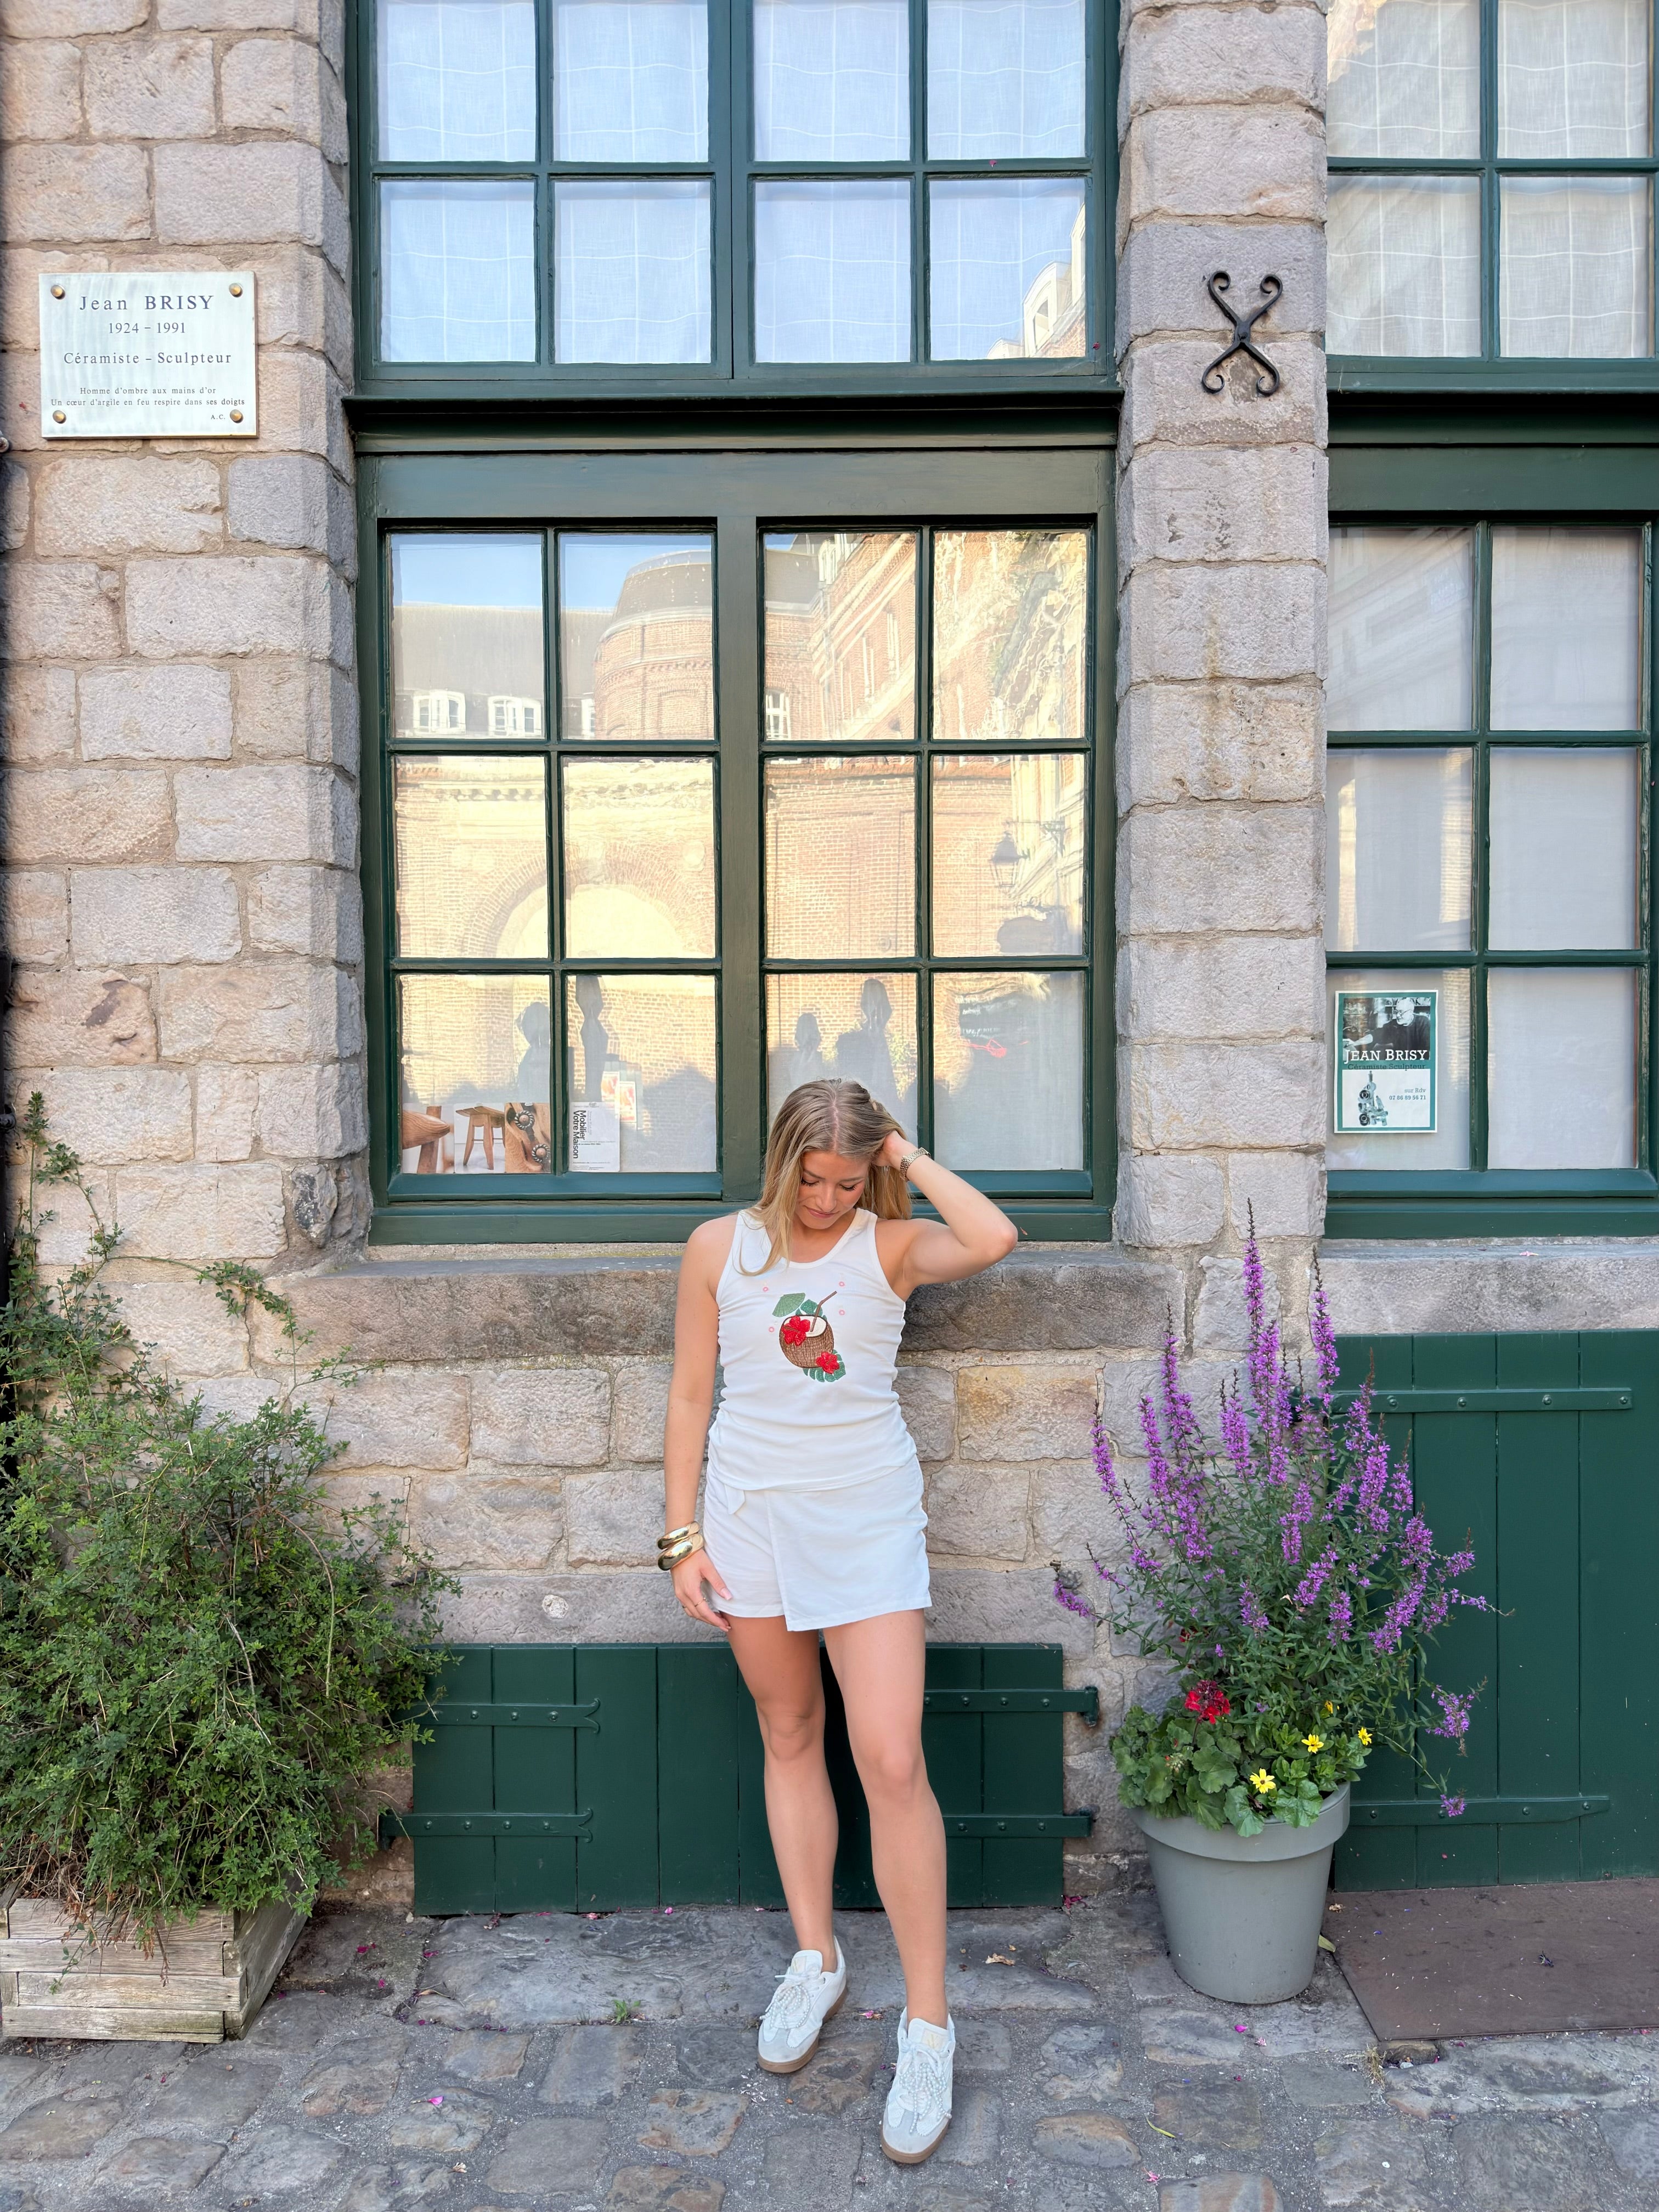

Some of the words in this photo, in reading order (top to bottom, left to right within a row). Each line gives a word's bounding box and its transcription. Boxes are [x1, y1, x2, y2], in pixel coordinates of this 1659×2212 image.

[80, 296, 128, 311] Jean
[144, 295, 214, 310] BRISY
[109, 323, 139, 334] 1924
[157, 322, 185, 334] 1991
[64, 352, 139, 364] Céramiste
[157, 352, 232, 365] Sculpteur
[90, 399, 120, 407] d'argile
[154, 398, 180, 407] respire
[221, 398, 245, 407] doigts
[1344, 1049, 1381, 1064] JEAN
[1385, 1049, 1427, 1060] BRISY
